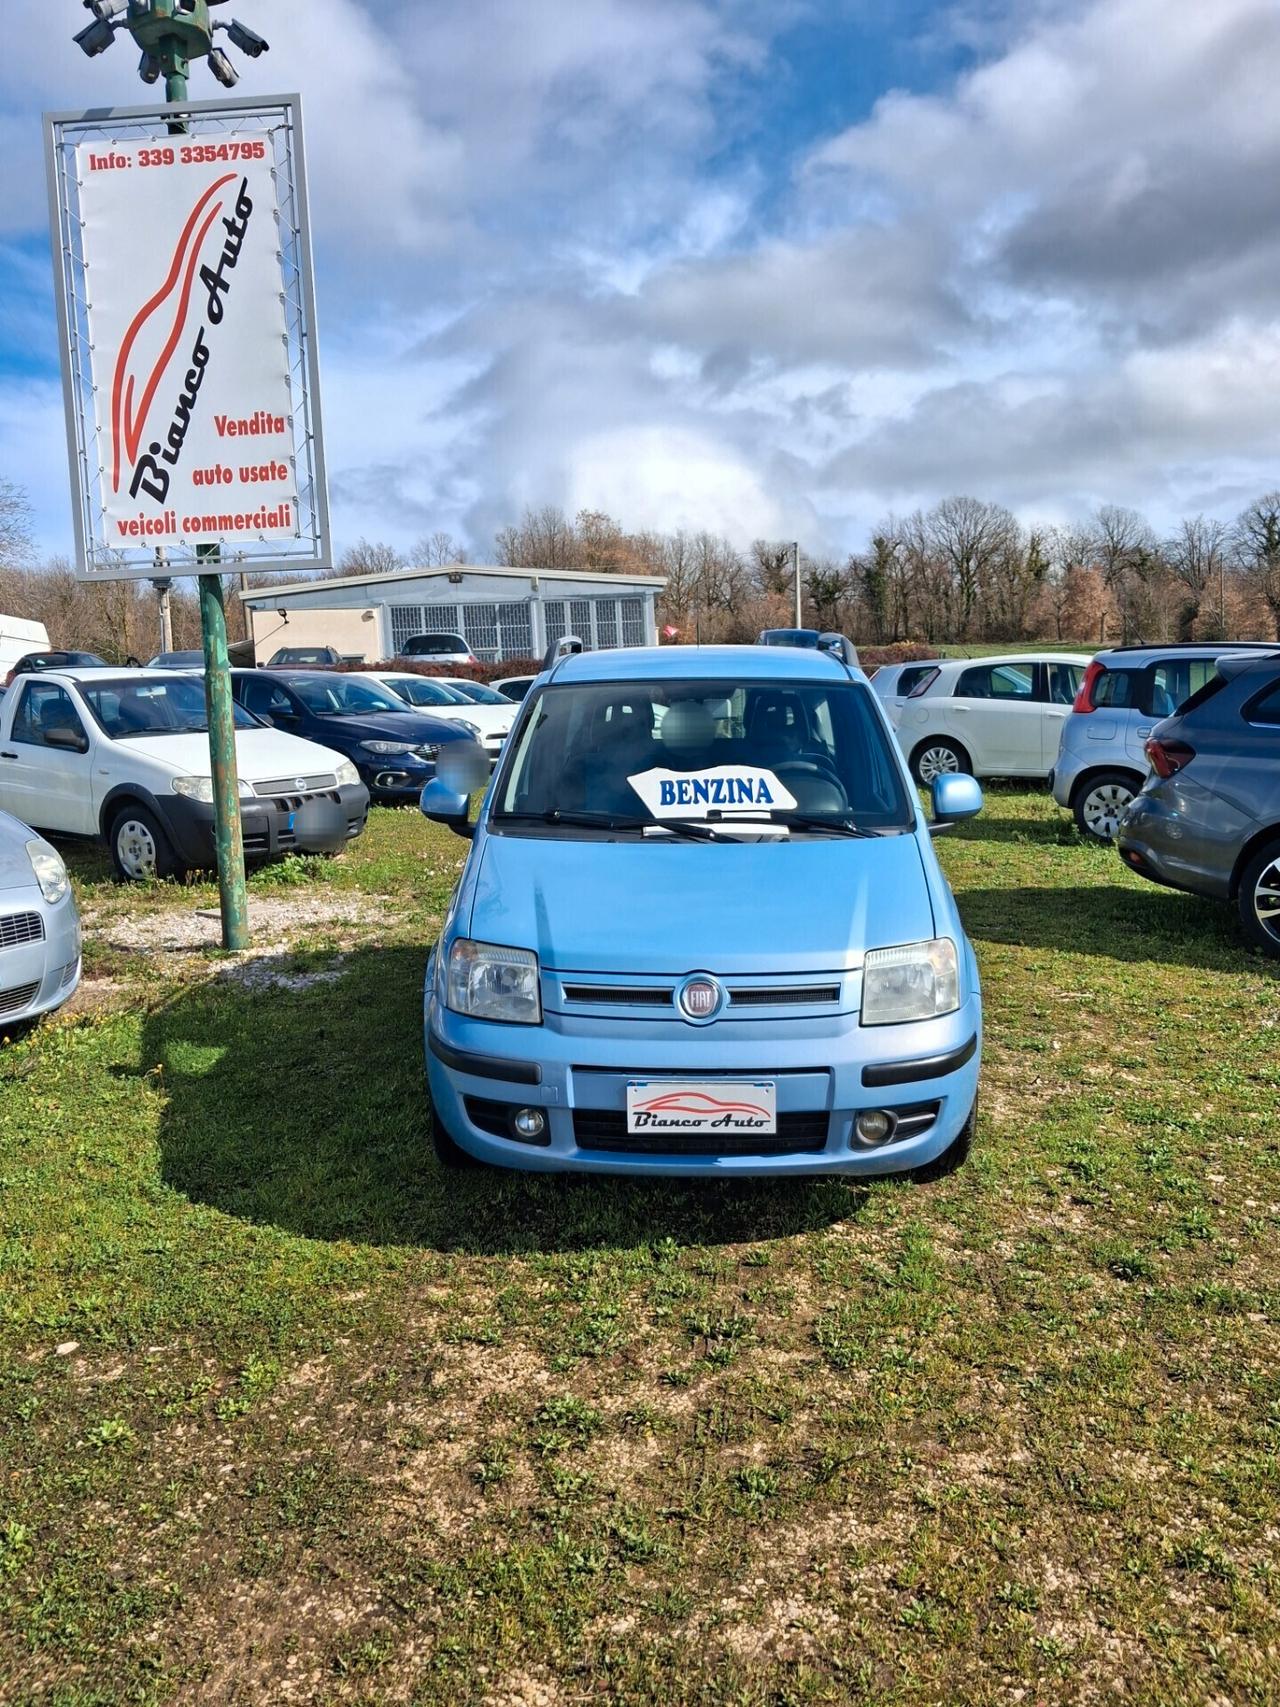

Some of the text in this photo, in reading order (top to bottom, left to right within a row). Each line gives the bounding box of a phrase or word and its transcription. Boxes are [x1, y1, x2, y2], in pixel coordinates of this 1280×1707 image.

[89, 141, 265, 171] Info: 339 3354795
[129, 176, 253, 504] Bianco Auto
[213, 411, 285, 437] Vendita
[192, 460, 288, 486] auto usate
[117, 504, 291, 536] veicoli commerciali
[660, 778, 774, 806] BENZINA
[690, 990, 712, 1007] FIAT
[632, 1111, 771, 1128] Bianco Auto
